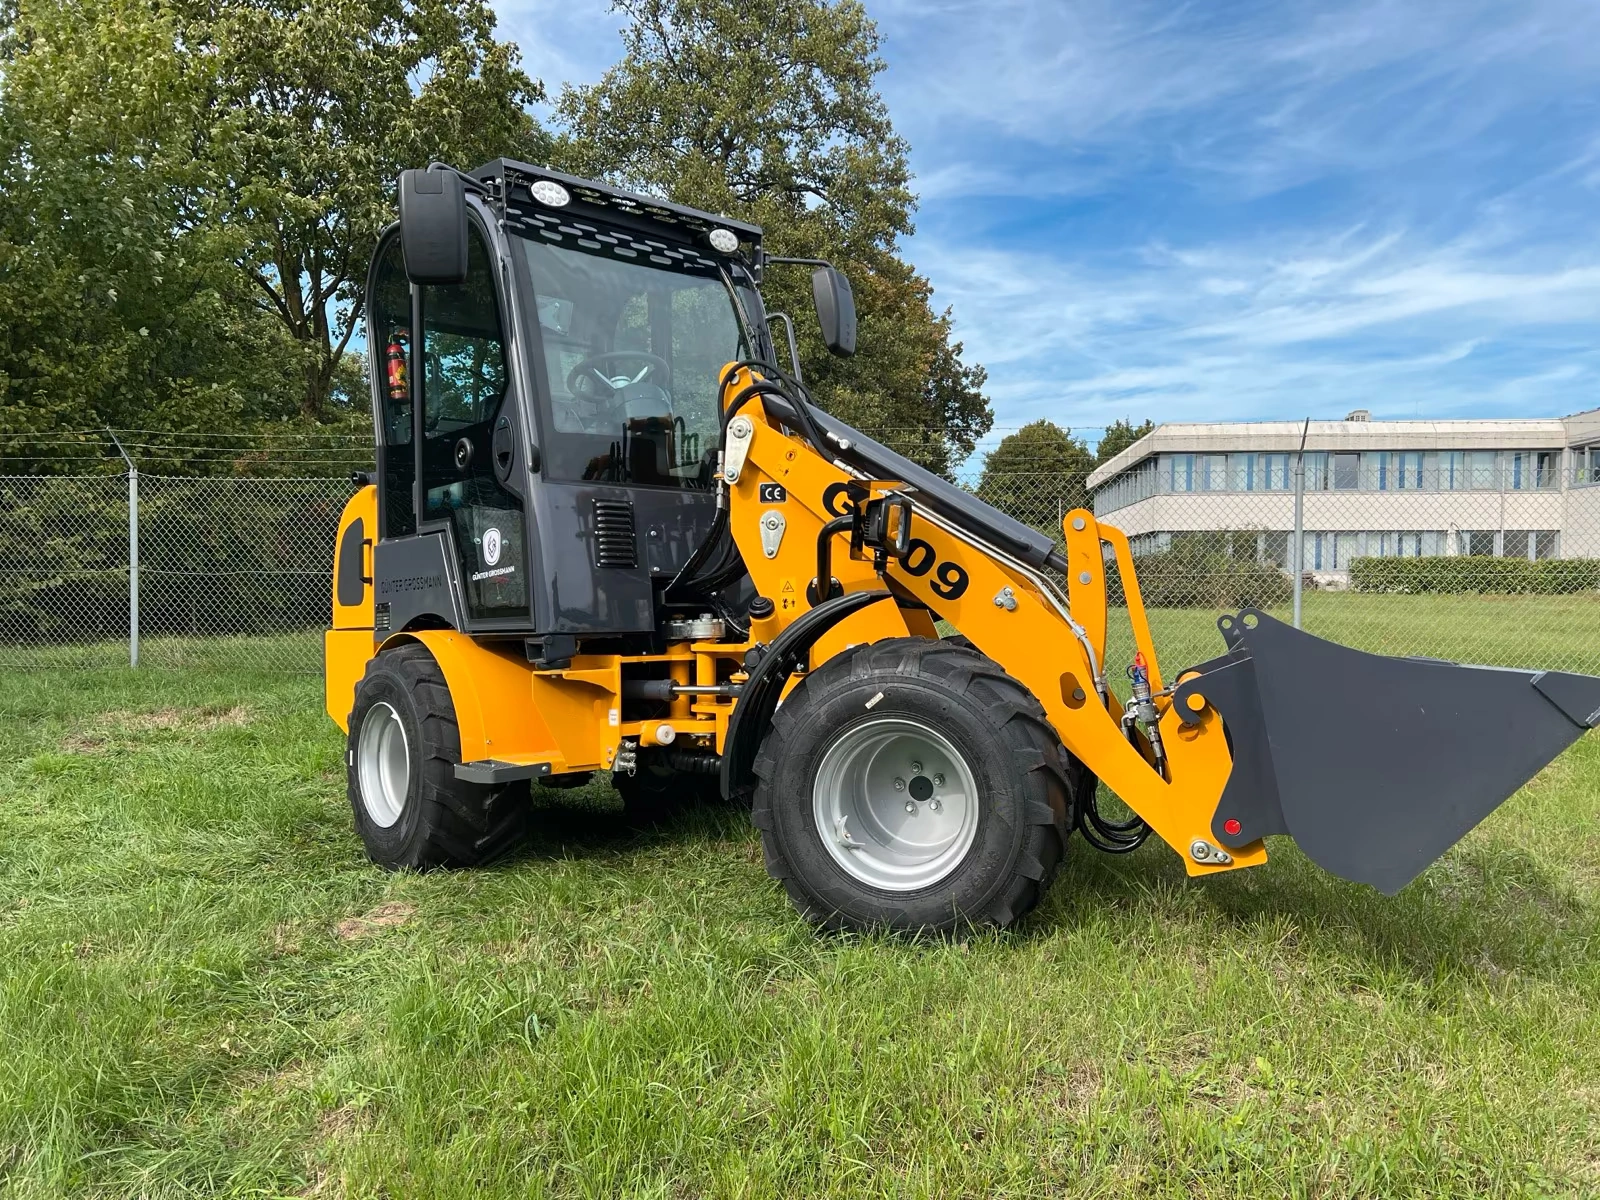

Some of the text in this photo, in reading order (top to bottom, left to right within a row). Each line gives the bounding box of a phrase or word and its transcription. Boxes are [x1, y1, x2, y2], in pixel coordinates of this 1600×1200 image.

[472, 565, 515, 581] GÜNTER GROSSMANN
[381, 575, 442, 594] GÜNTER GROSSMANN
